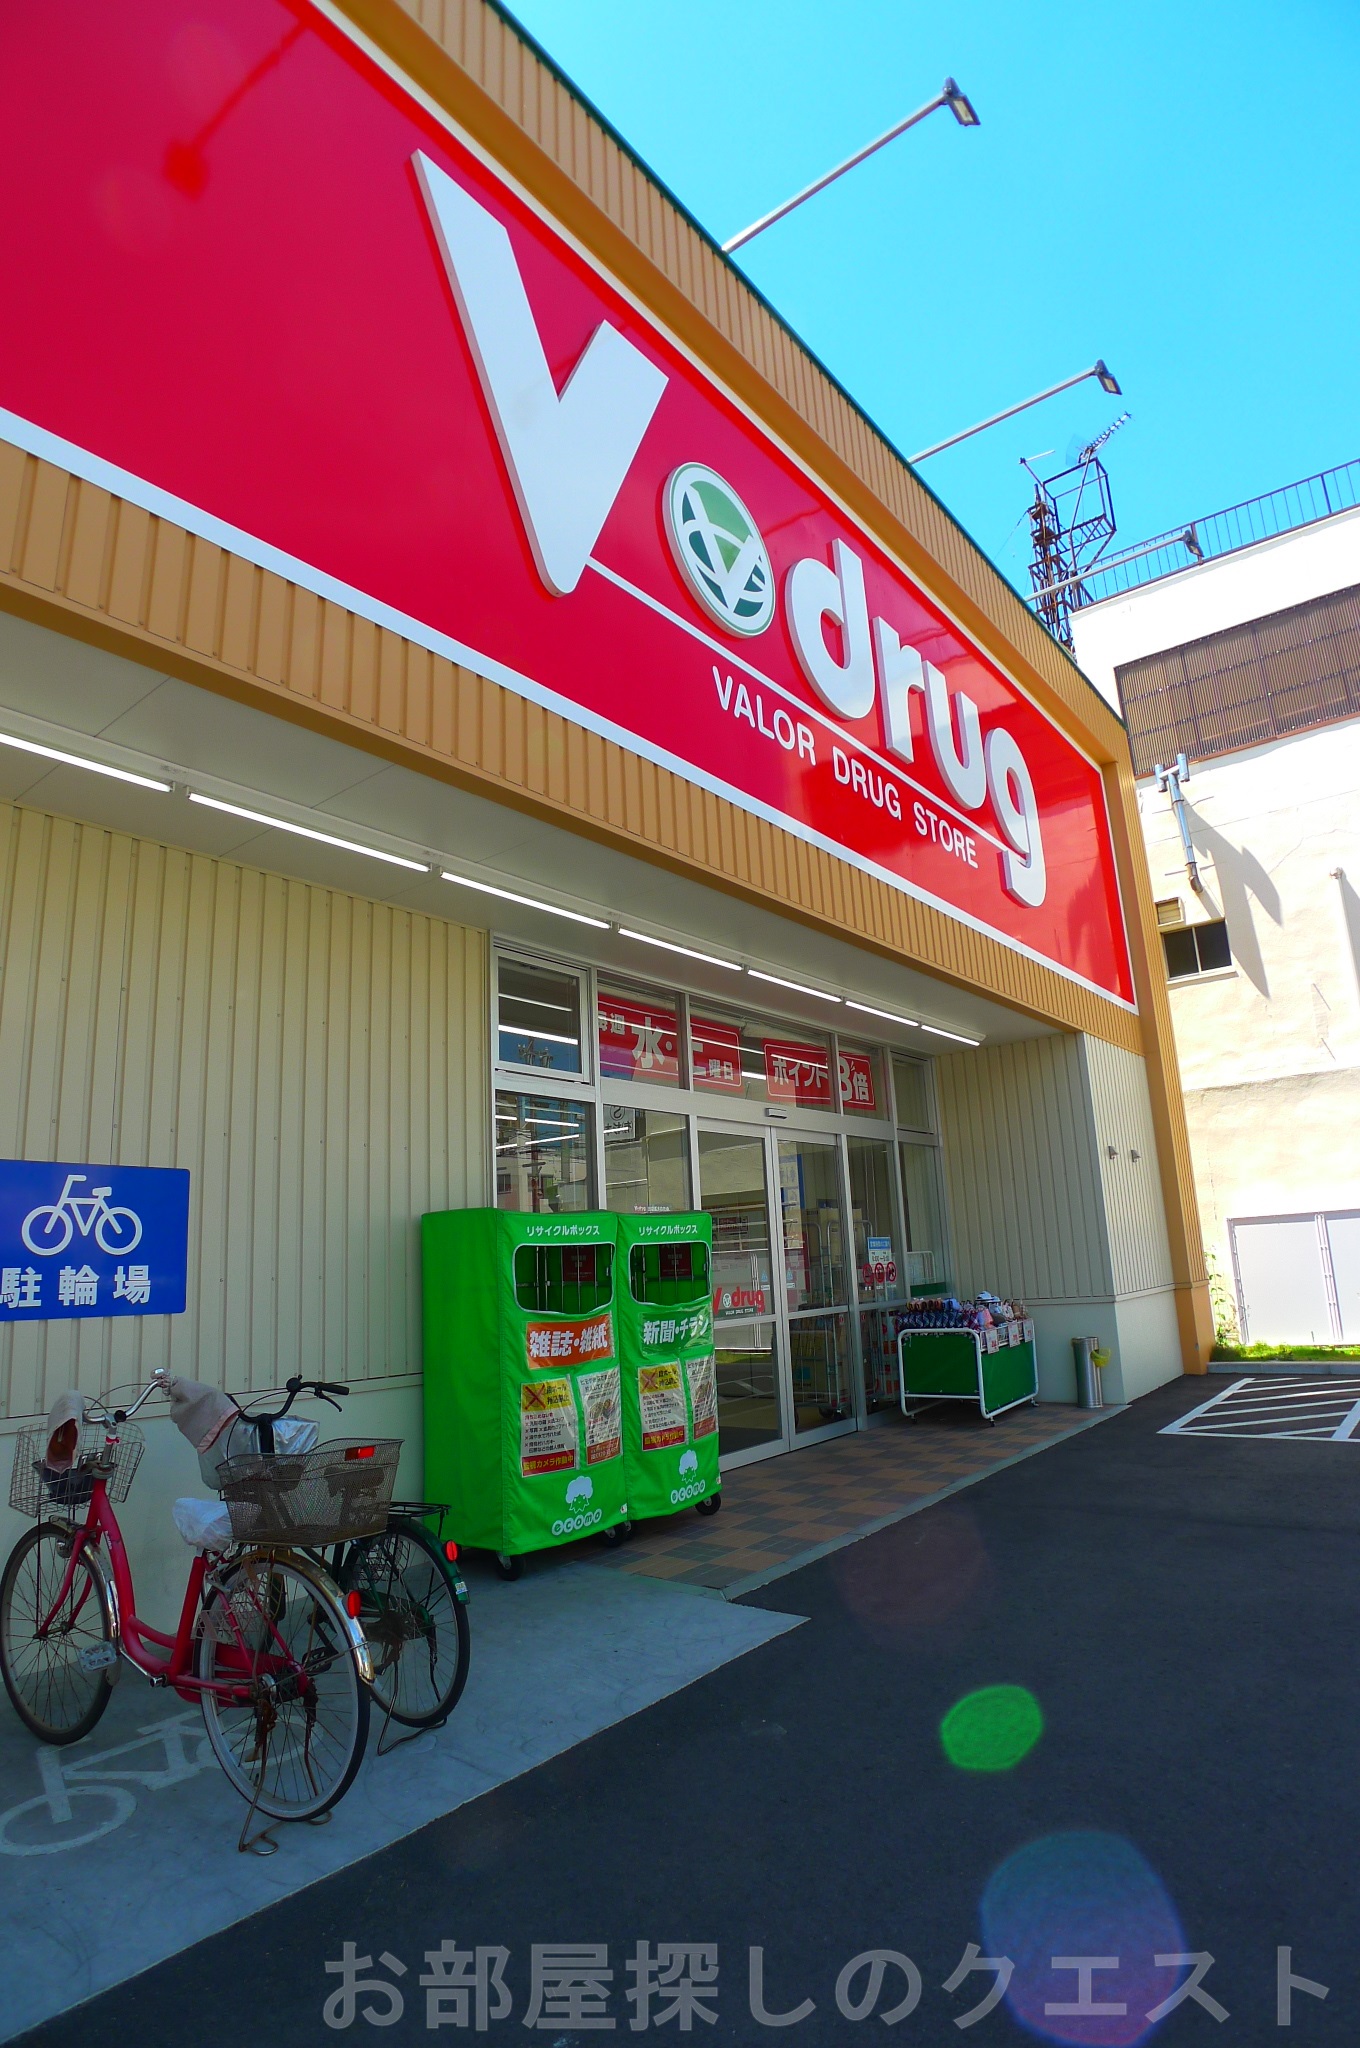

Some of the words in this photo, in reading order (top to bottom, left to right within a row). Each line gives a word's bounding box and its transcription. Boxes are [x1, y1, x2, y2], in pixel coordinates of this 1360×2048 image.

[785, 538, 1047, 908] drug
[712, 665, 816, 766] VALOR
[832, 745, 902, 821] DRUG
[913, 801, 979, 869] STORE
[526, 1225, 600, 1237] リサイクルボックス
[638, 1224, 698, 1237] リサイクルボックス
[0, 1264, 151, 1309] 駐輪場
[529, 1322, 608, 1358] 雑誌・雑紙
[643, 1315, 710, 1346] 新聞・チラシ
[551, 1508, 602, 1536] ecomo
